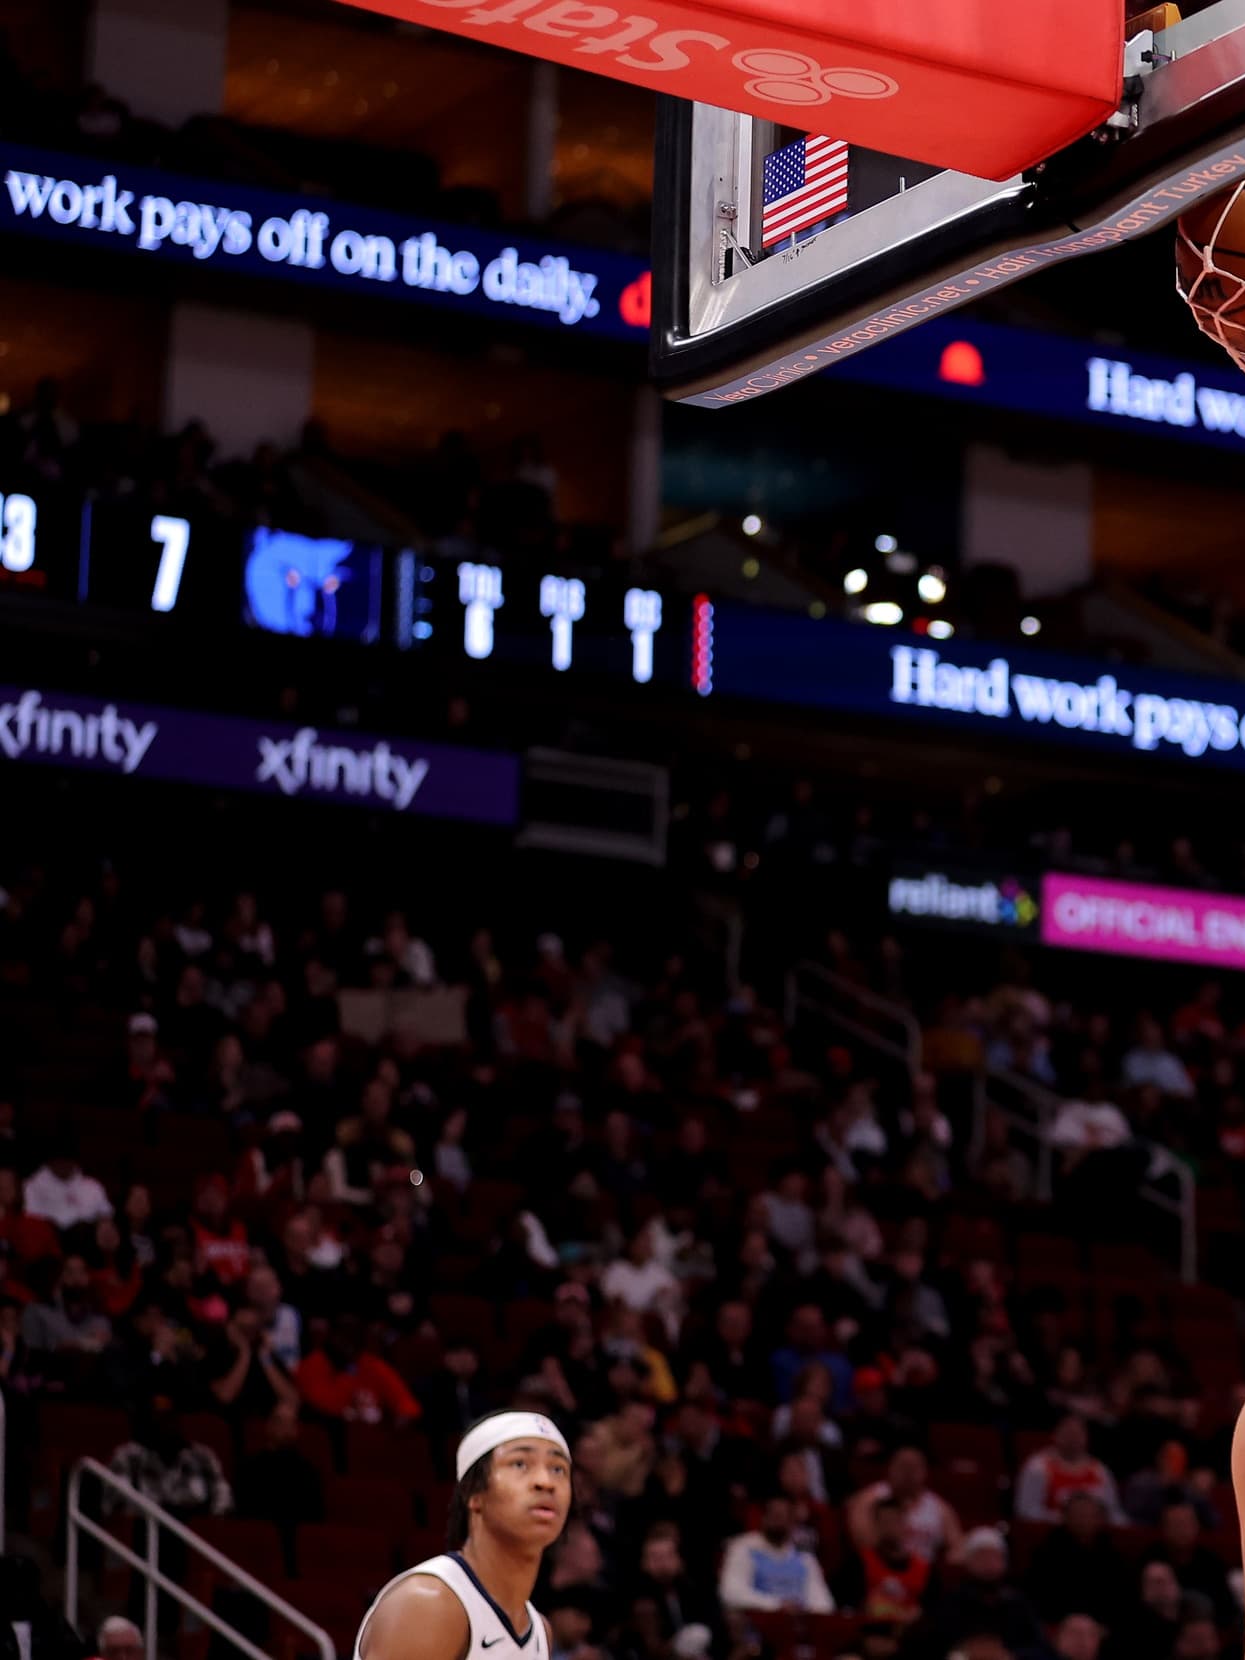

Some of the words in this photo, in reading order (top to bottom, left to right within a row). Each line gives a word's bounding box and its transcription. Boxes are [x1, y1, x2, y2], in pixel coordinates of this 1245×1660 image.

[5, 170, 135, 235] work
[137, 195, 252, 259] pays
[257, 209, 330, 269] off
[330, 230, 398, 282] on
[399, 232, 480, 295] the
[482, 247, 600, 325] daily.
[817, 284, 970, 355] veraclinic.net
[974, 253, 1037, 281] Hair
[1029, 202, 1169, 258] Transplant
[1087, 357, 1198, 427] Hard
[0, 491, 37, 572] 3
[151, 515, 190, 612] 7
[890, 645, 1011, 718] Hard
[1011, 674, 1133, 736] work
[1132, 693, 1239, 757] pays
[256, 727, 430, 811] xfinity
[889, 872, 1000, 924] reliant
[1055, 891, 1196, 946] OFFICIAL
